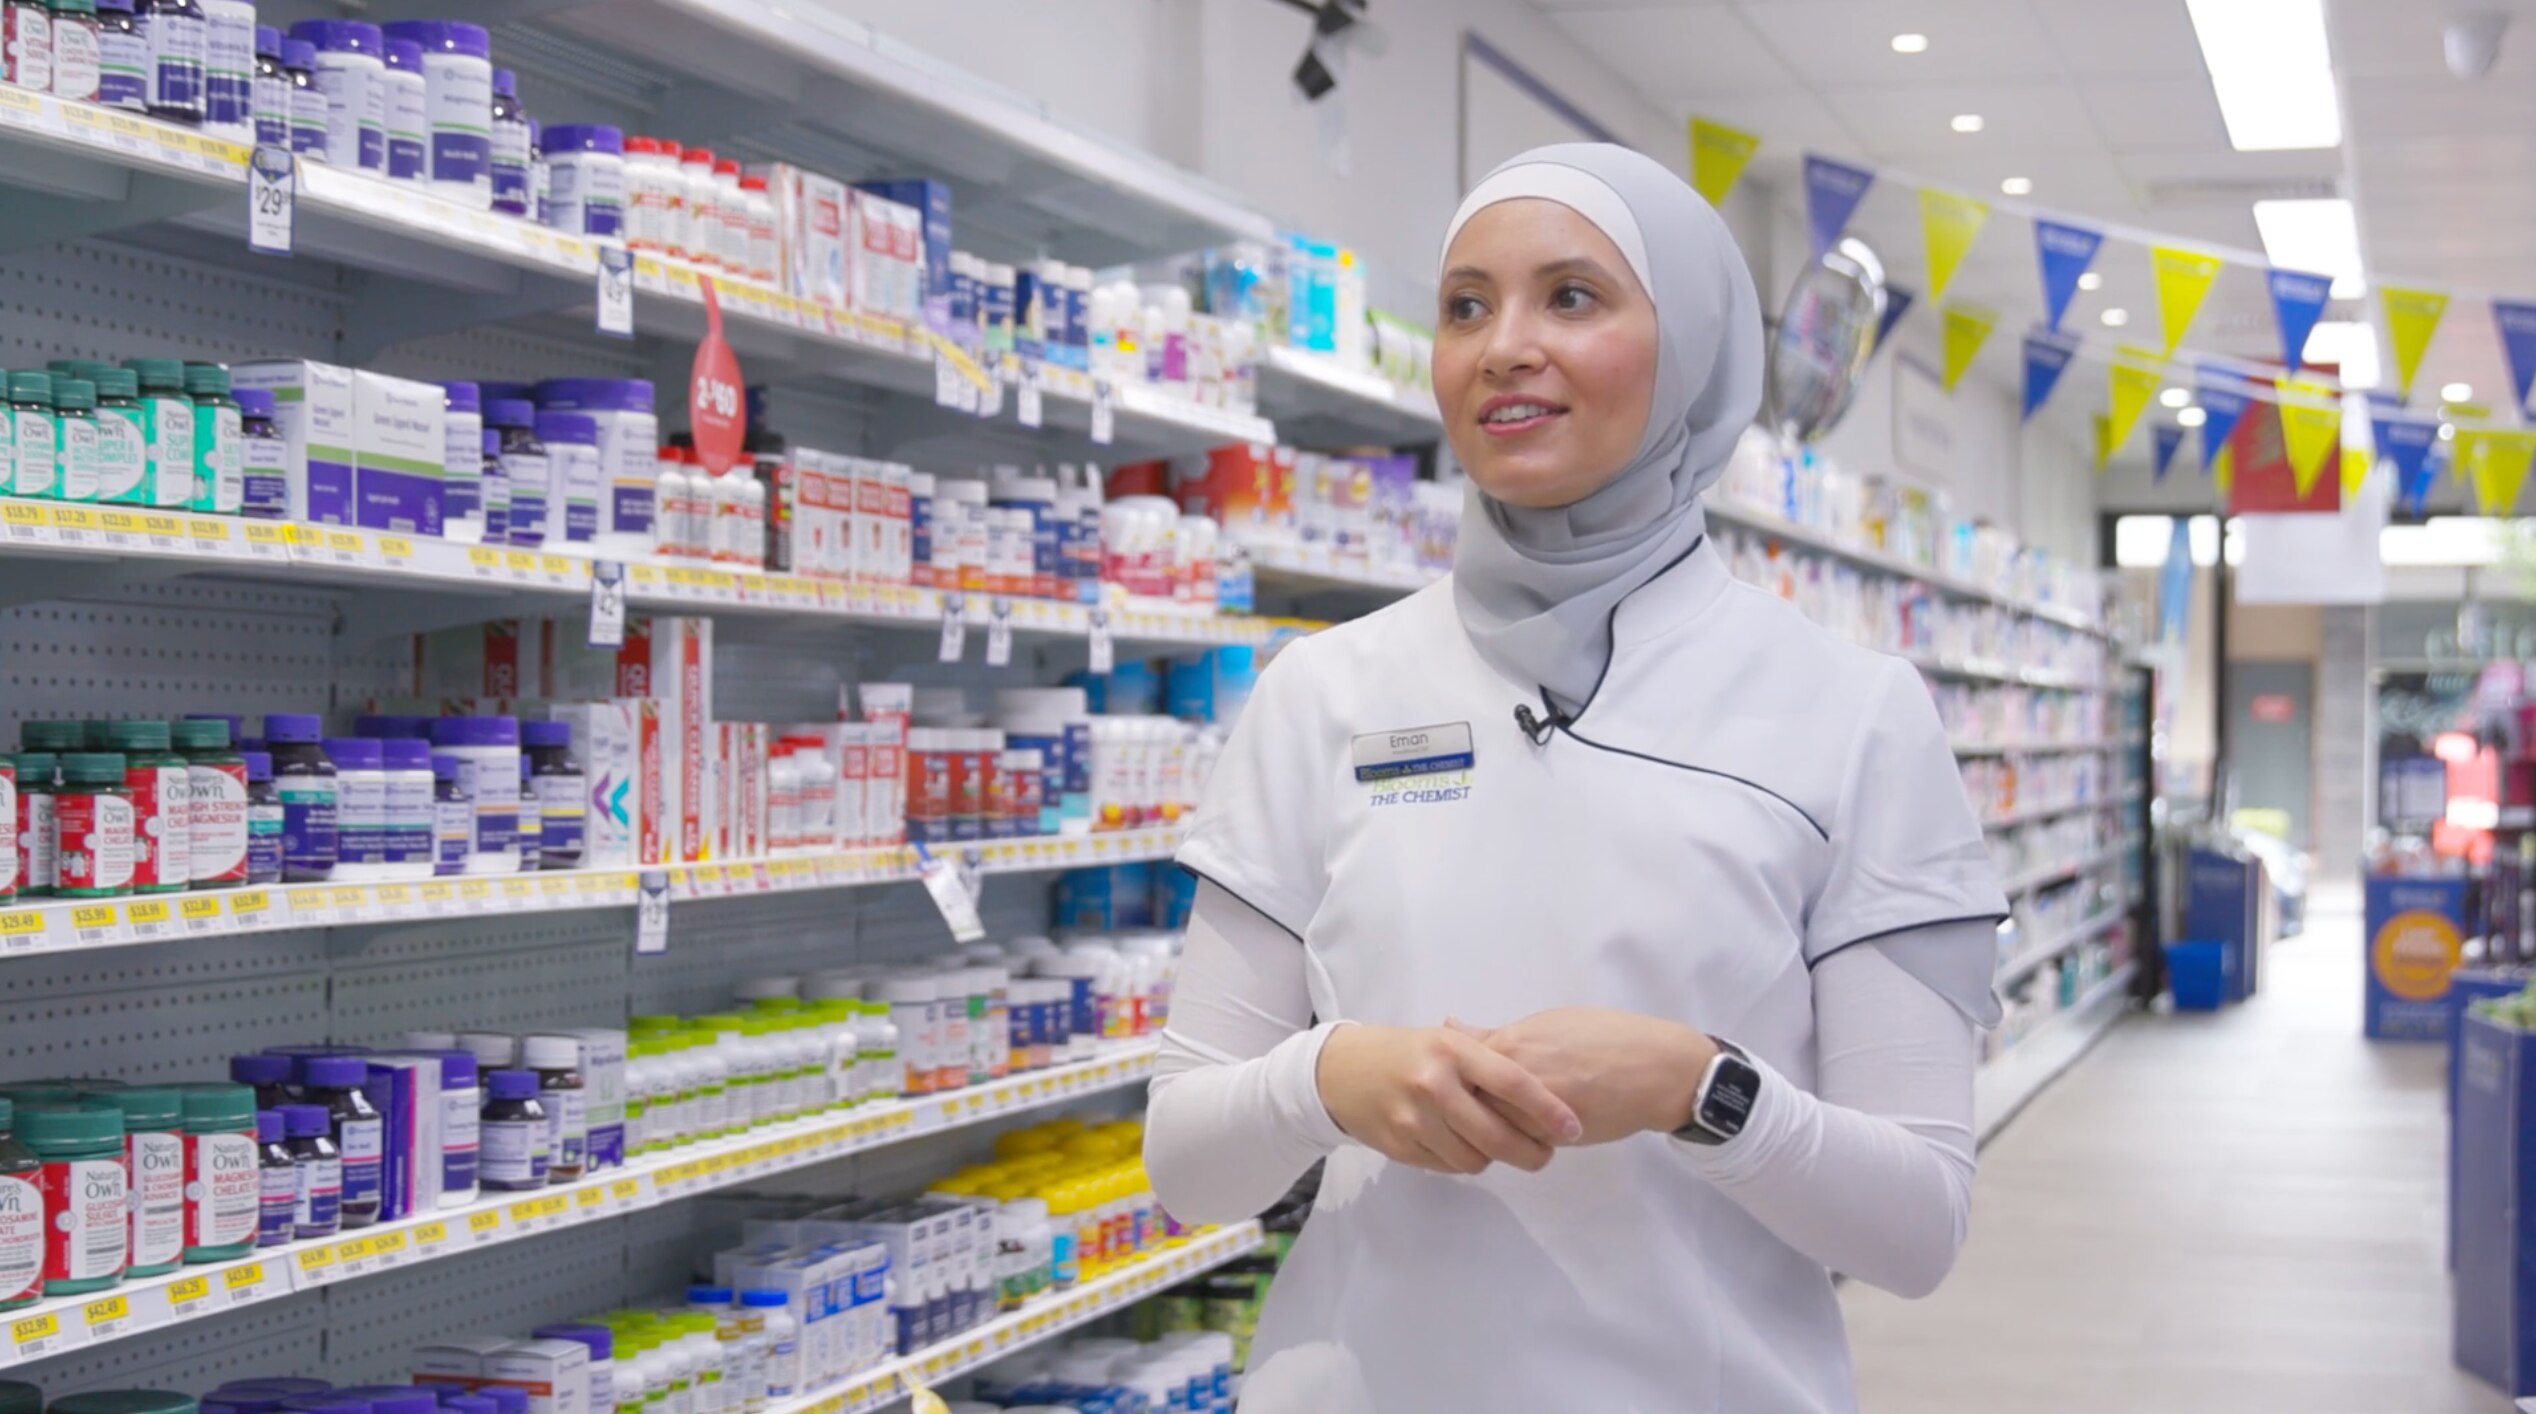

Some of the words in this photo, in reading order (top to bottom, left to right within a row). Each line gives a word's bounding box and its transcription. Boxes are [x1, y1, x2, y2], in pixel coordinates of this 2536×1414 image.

[1390, 733, 1429, 749] Eman
[1370, 793, 1399, 807] THE
[1402, 786, 1472, 803] CHEMIST
[143, 1153, 180, 1170] Own
[213, 1154, 250, 1170] Own
[86, 1181, 121, 1199] Own
[15, 1317, 48, 1338] $32.99
